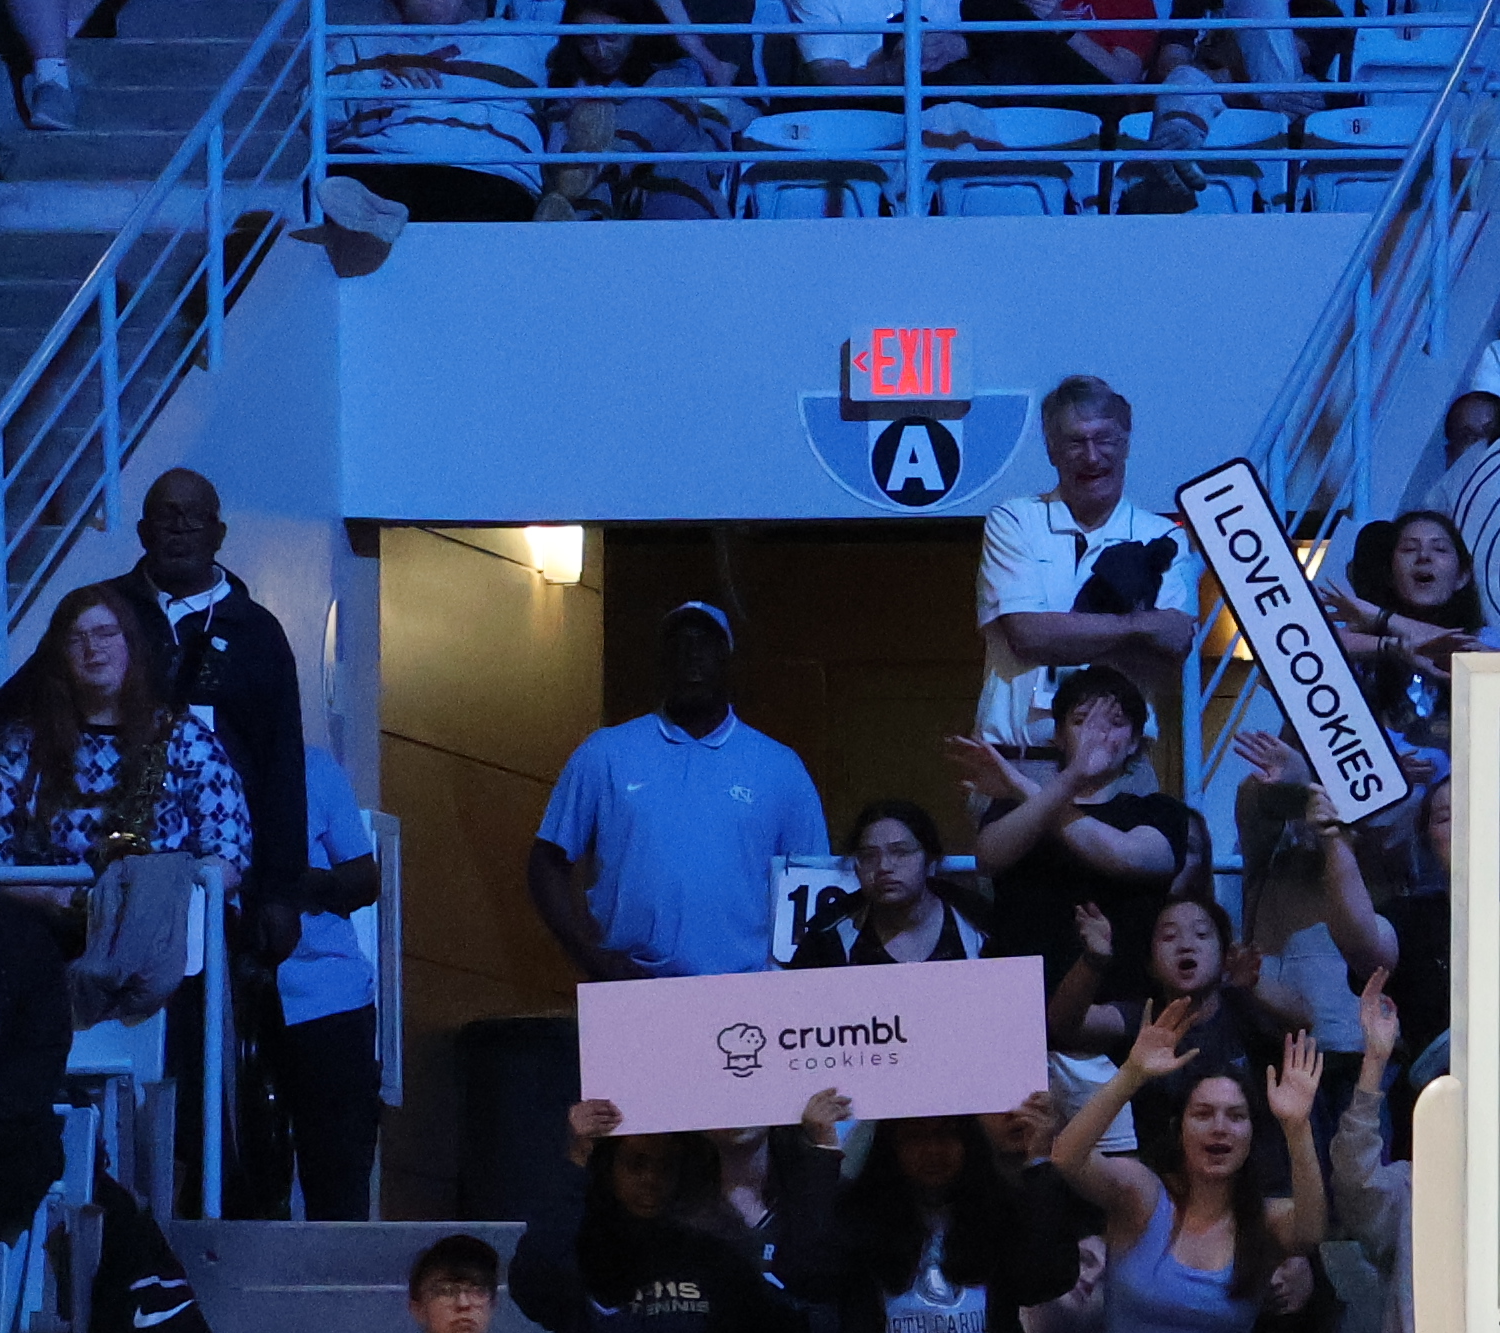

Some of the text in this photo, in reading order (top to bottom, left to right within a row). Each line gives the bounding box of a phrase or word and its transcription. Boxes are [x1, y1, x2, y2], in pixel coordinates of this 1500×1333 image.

[870, 327, 958, 397] EXIT
[885, 424, 946, 492] A
[1203, 484, 1384, 802] I LOVE COOKIES
[778, 1014, 909, 1050] crumbl
[788, 1051, 899, 1071] cookies
